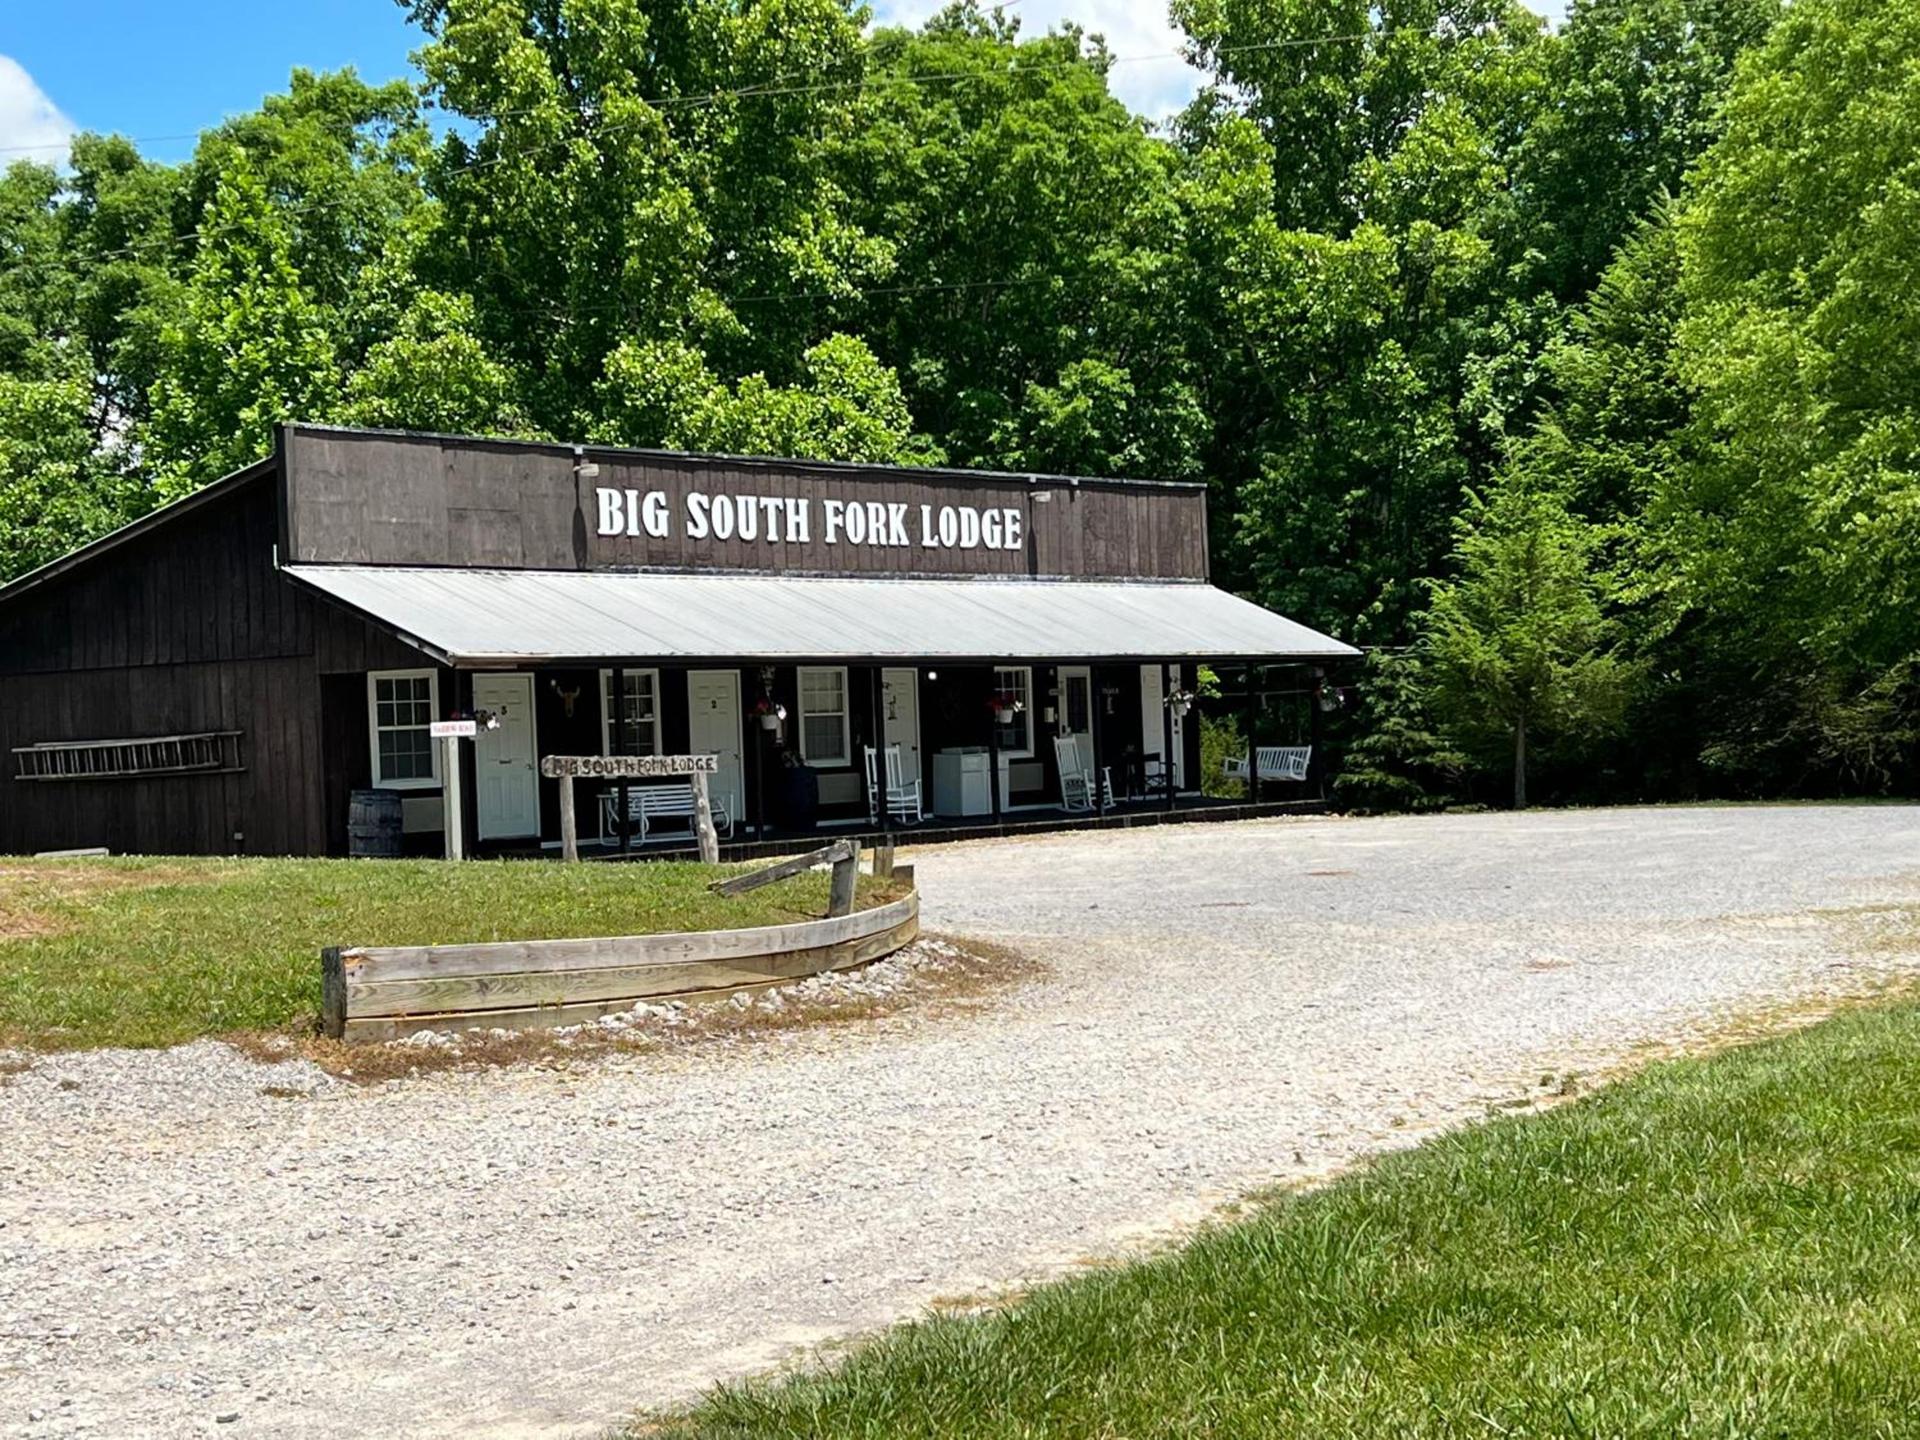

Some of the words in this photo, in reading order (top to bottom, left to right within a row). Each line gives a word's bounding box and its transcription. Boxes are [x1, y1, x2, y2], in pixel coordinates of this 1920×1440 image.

[596, 487, 669, 538] BIG
[686, 491, 810, 544] SOUTH
[824, 499, 909, 547] FORK
[920, 504, 1023, 550] LODGE
[553, 758, 578, 775] BIG
[582, 759, 635, 774] SOUTH
[638, 759, 668, 775] FORK
[671, 757, 715, 772] LODGE
